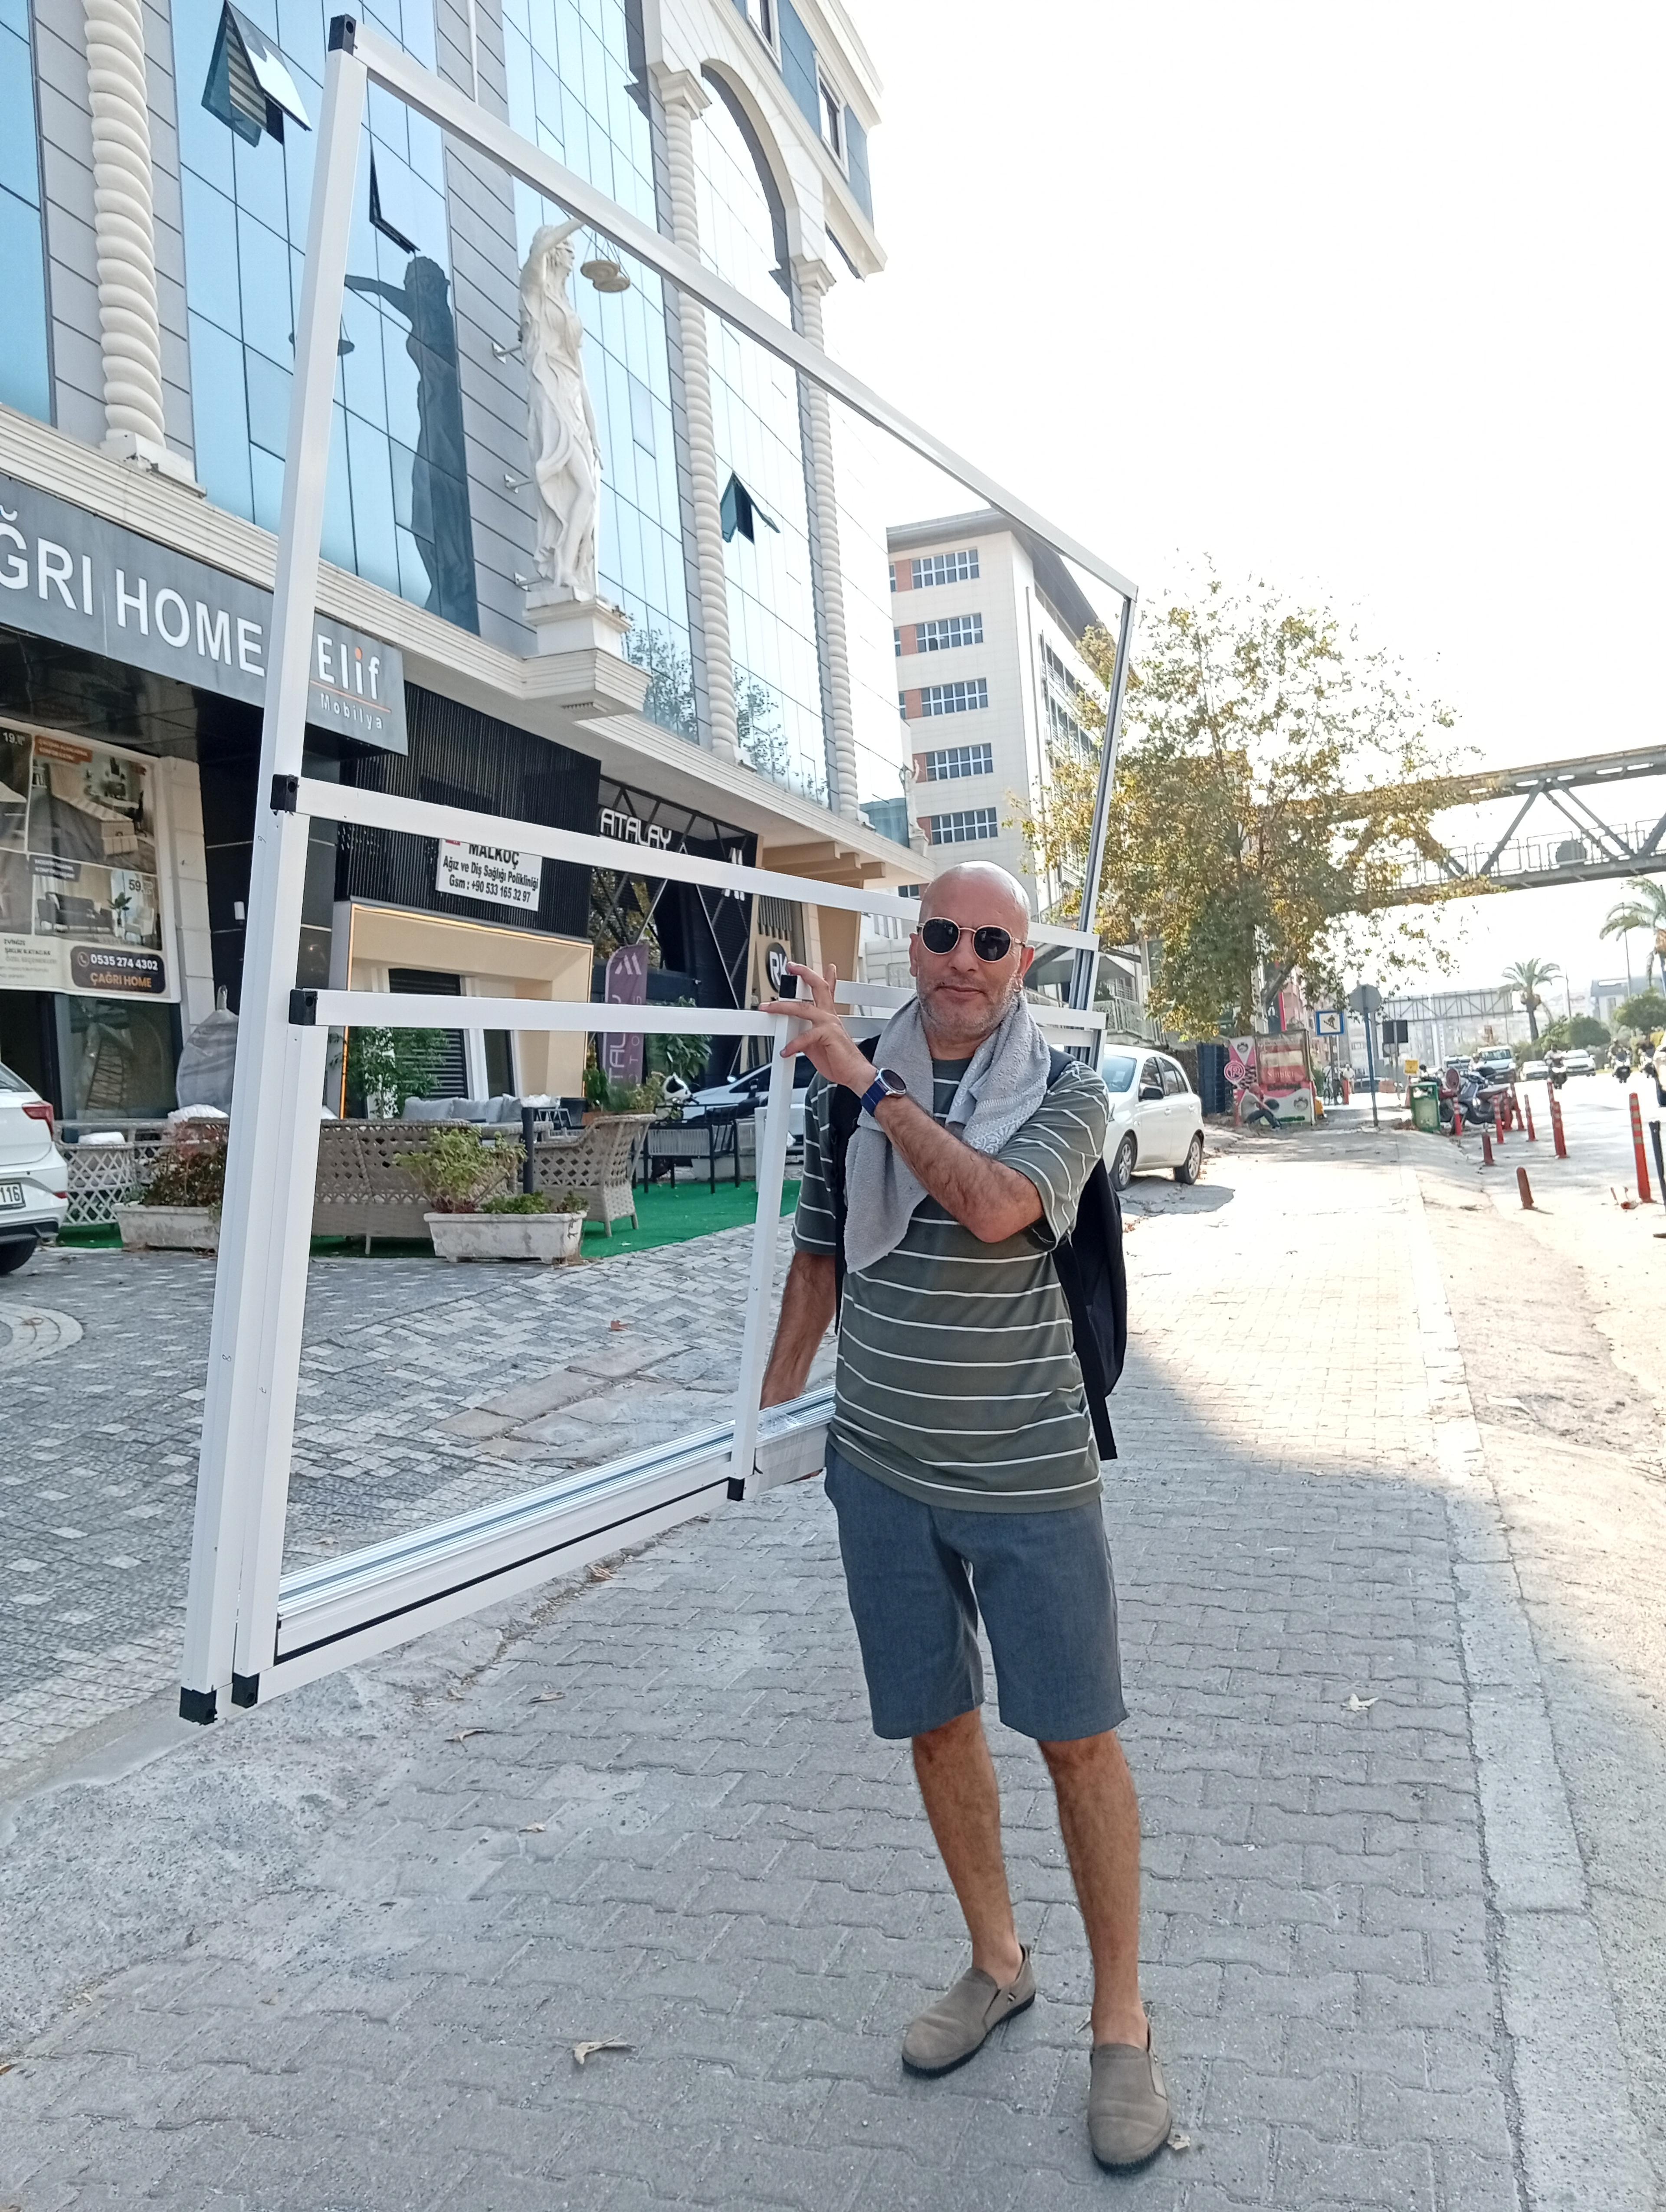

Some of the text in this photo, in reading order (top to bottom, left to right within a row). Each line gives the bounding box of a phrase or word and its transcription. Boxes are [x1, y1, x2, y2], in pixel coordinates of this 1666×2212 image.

[115, 568, 266, 677] HOME
[317, 634, 381, 700] Elif
[321, 693, 383, 731] Mobilya
[600, 808, 672, 850] ATALAY
[443, 855, 459, 872] Ağız
[461, 862, 469, 873] ve
[471, 861, 482, 878] Diş
[469, 844, 520, 870] MALKOÇ
[449, 874, 466, 889] Gsm
[472, 880, 484, 893] +90
[485, 882, 498, 896] 533
[500, 885, 512, 899] 165
[513, 889, 521, 901] 32
[522, 891, 531, 903] 97
[90, 954, 158, 971] 0535 274 4302
[90, 972, 151, 988] ÇAĞRI HOME
